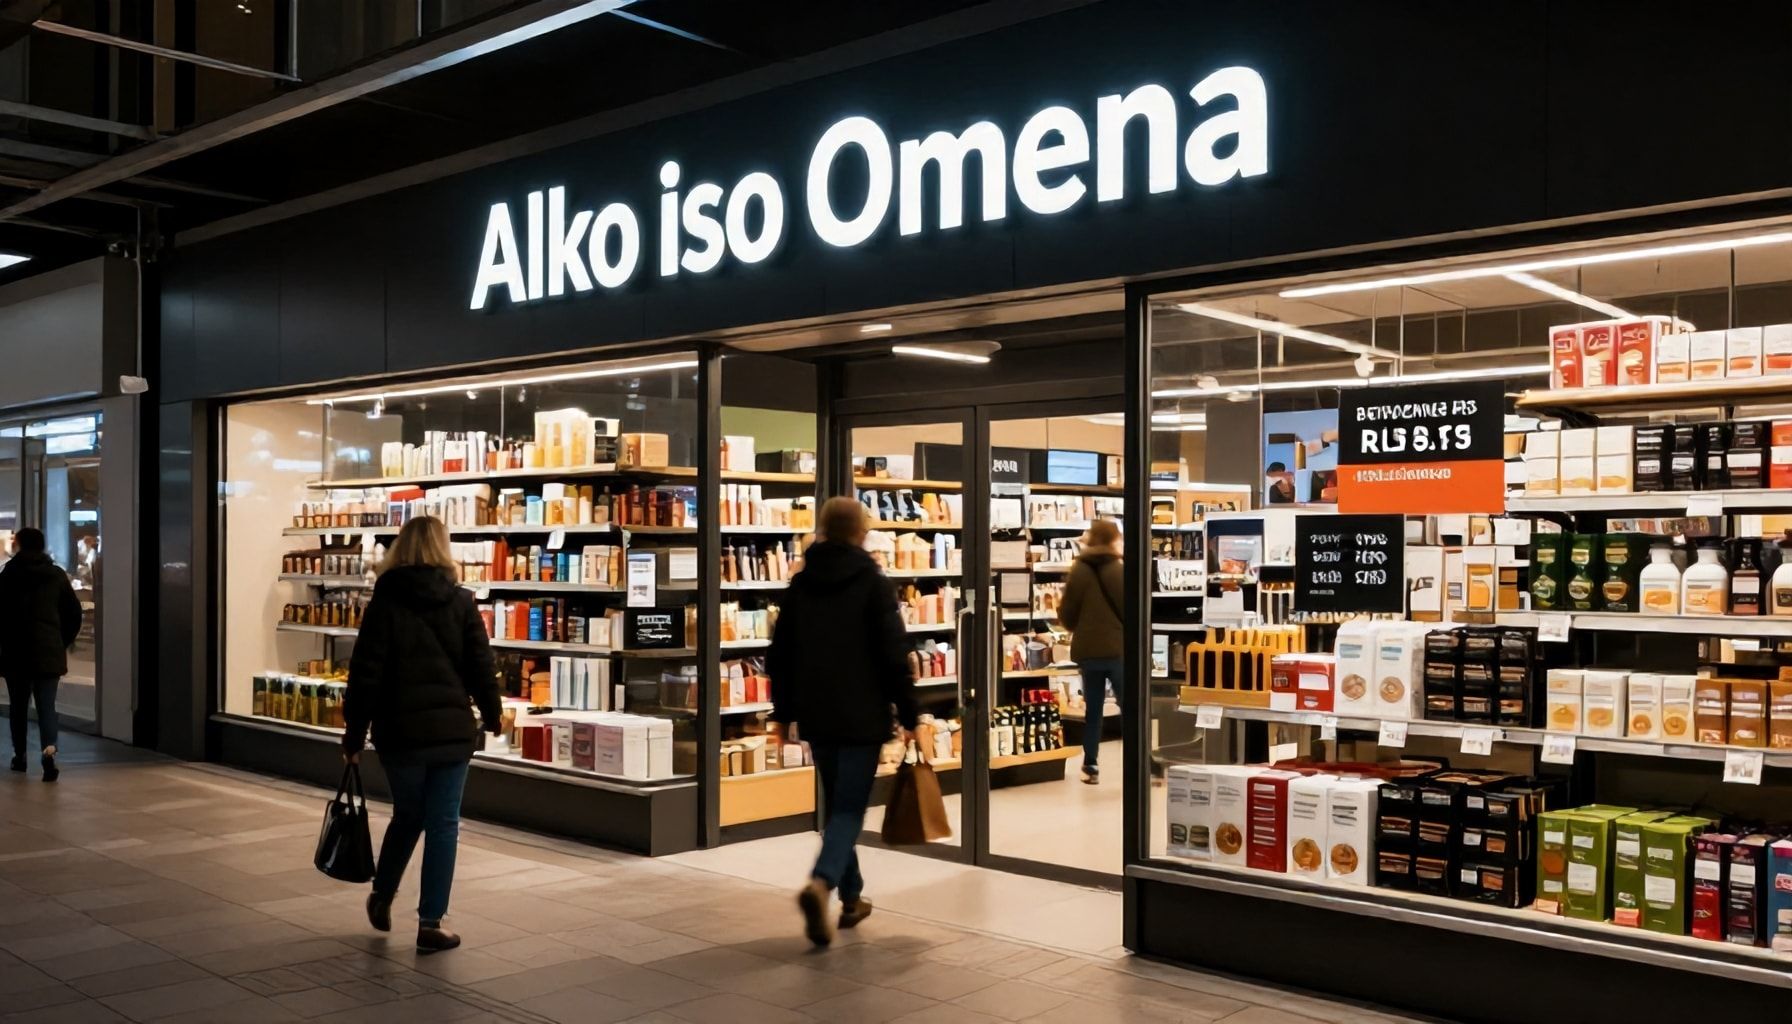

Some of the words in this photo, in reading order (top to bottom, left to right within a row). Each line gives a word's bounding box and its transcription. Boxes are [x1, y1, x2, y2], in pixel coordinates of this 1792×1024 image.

[470, 186, 640, 310] Alko
[660, 160, 784, 277] iso
[806, 65, 1268, 248] Omena
